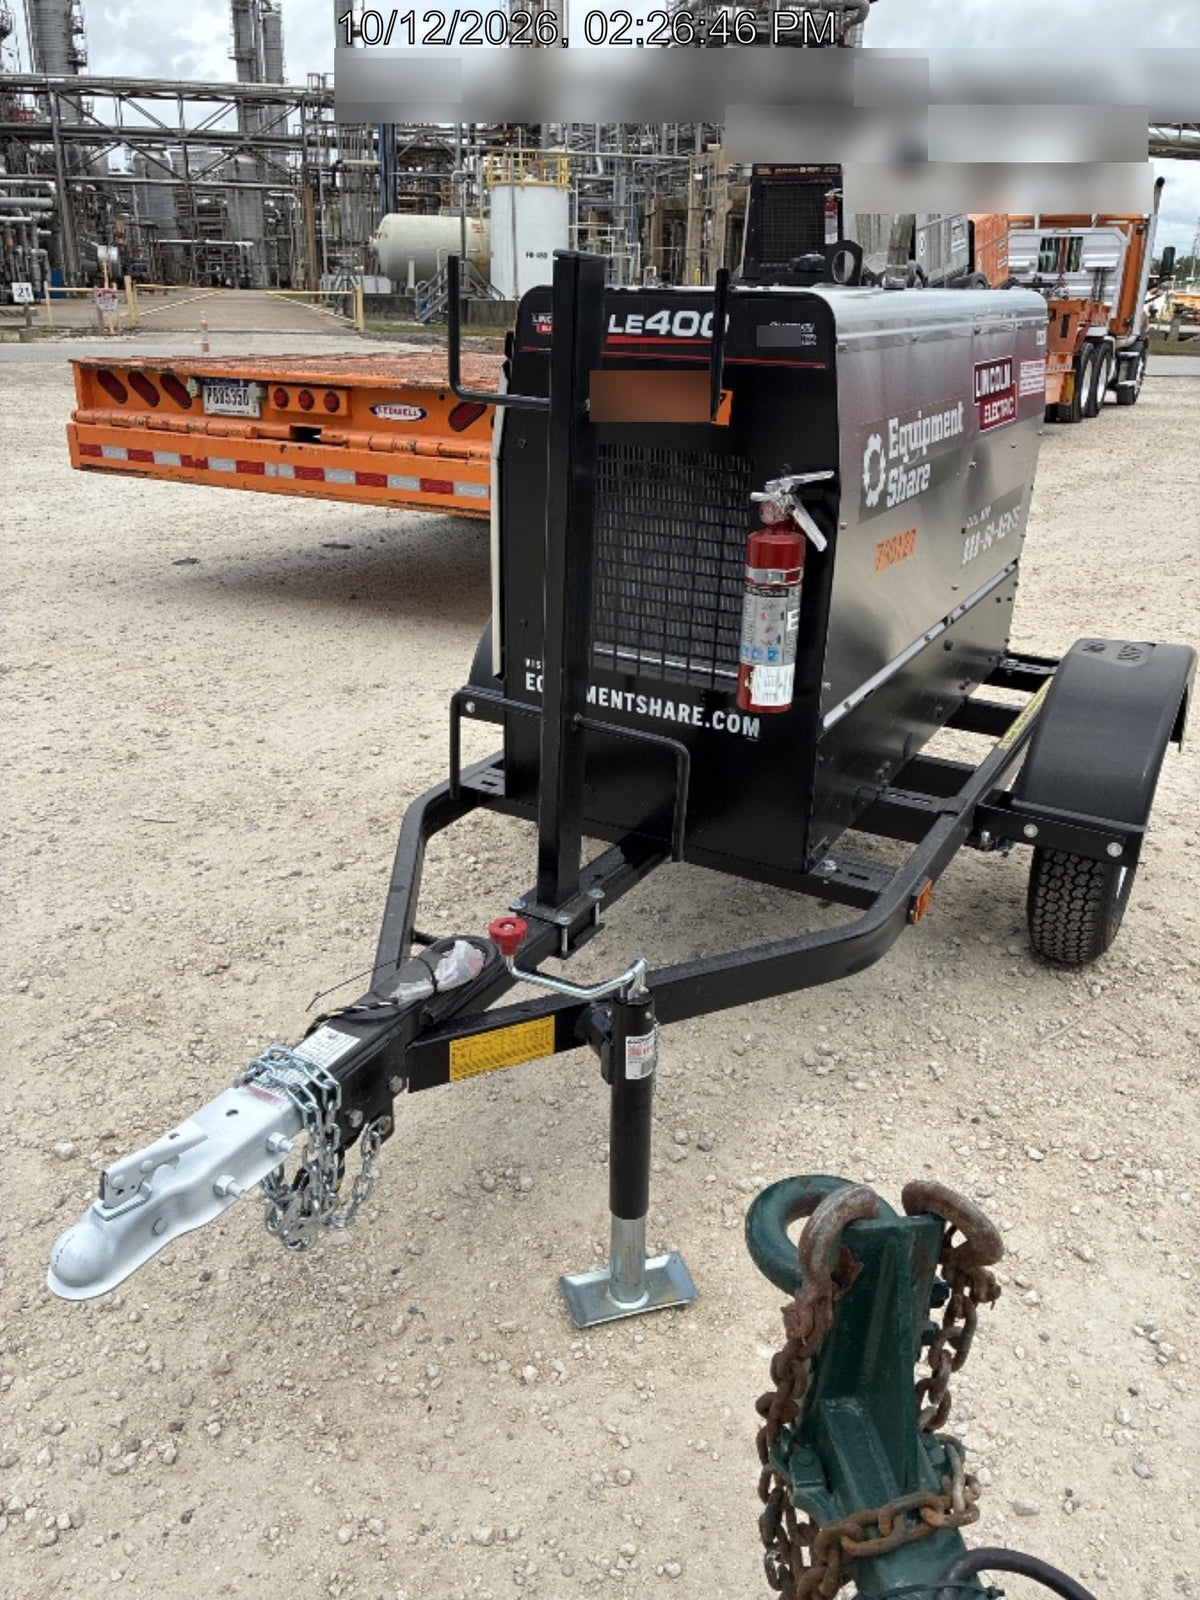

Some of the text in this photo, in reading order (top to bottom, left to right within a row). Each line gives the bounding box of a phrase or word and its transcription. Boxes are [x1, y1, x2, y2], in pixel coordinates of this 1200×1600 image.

[974, 362, 1012, 398] LINCOLN
[983, 396, 1015, 425] ELECTRIC
[887, 401, 964, 463] Equipment
[886, 463, 931, 508] Share
